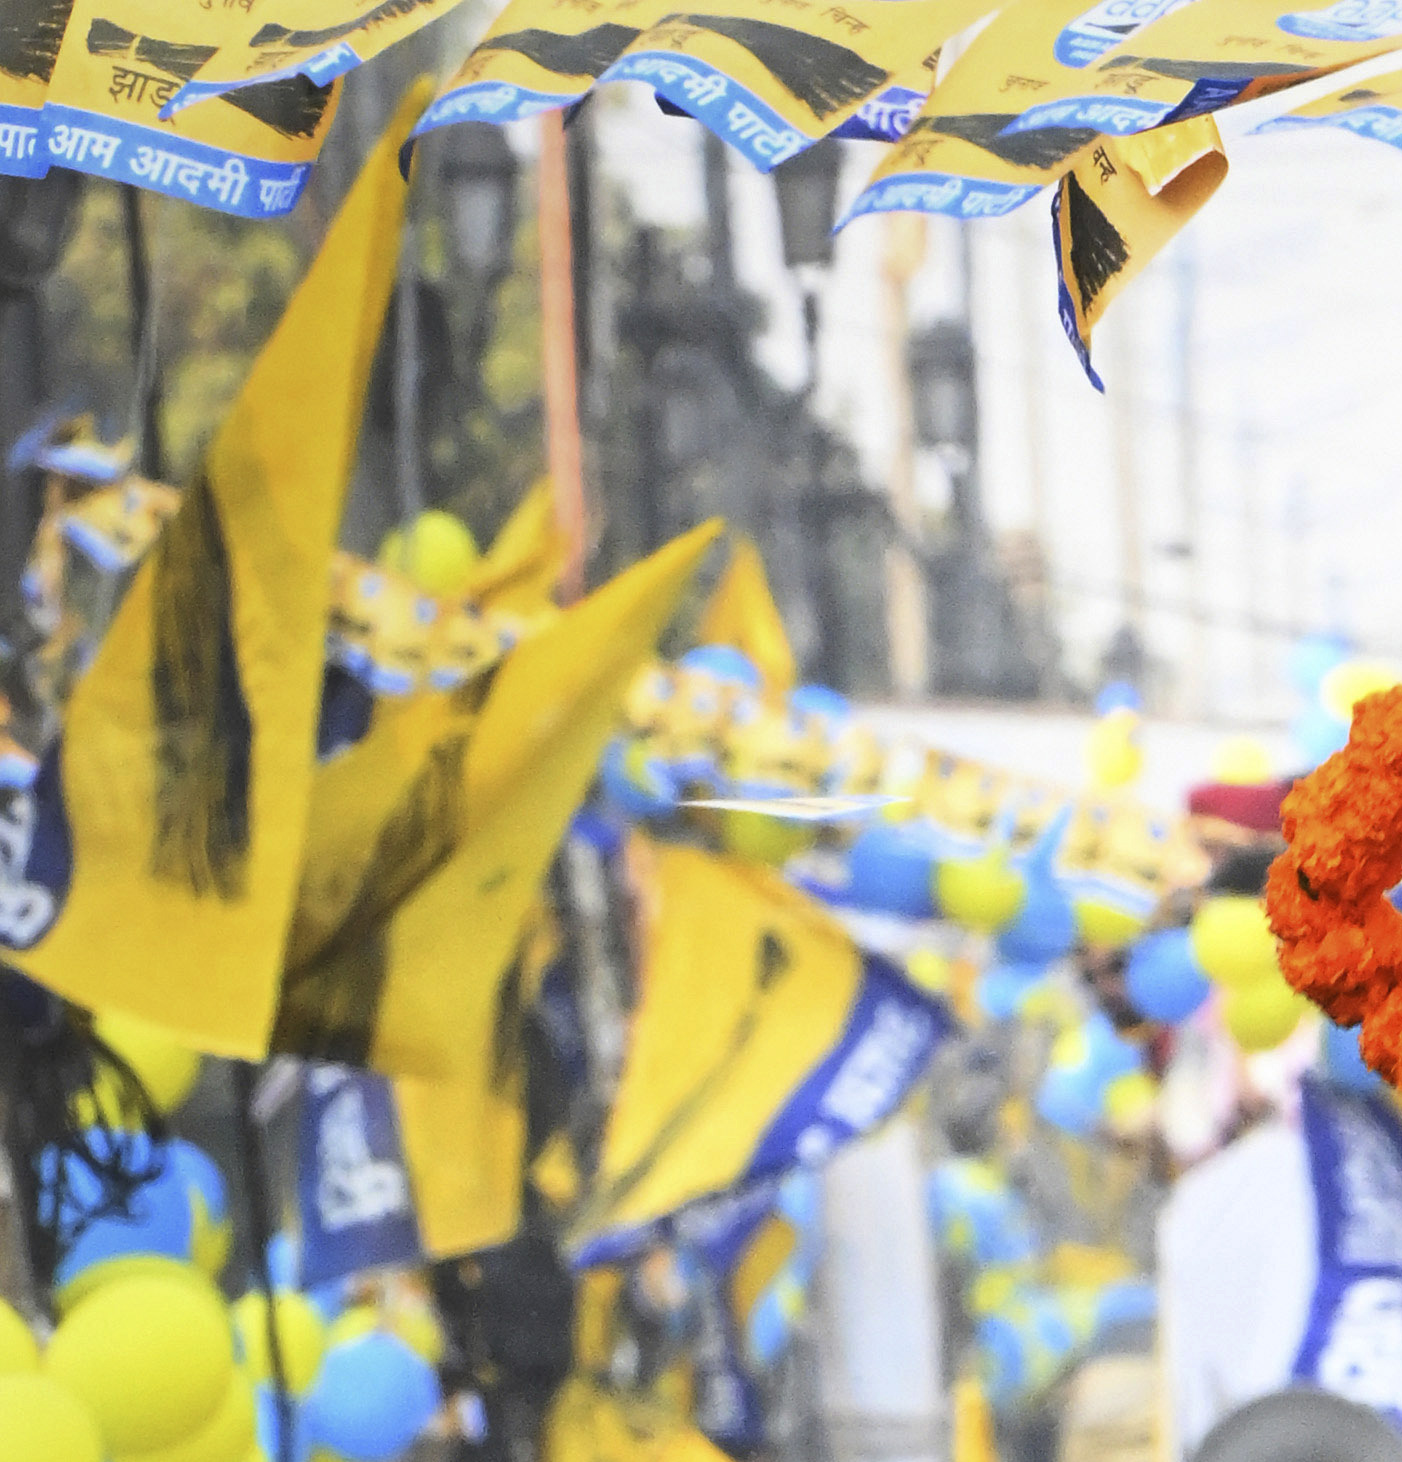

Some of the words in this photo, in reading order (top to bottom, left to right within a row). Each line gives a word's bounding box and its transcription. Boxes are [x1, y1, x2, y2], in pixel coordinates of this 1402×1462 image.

[109, 66, 177, 126] झाड
[48, 124, 122, 168] आम
[129, 146, 250, 206] आदमी
